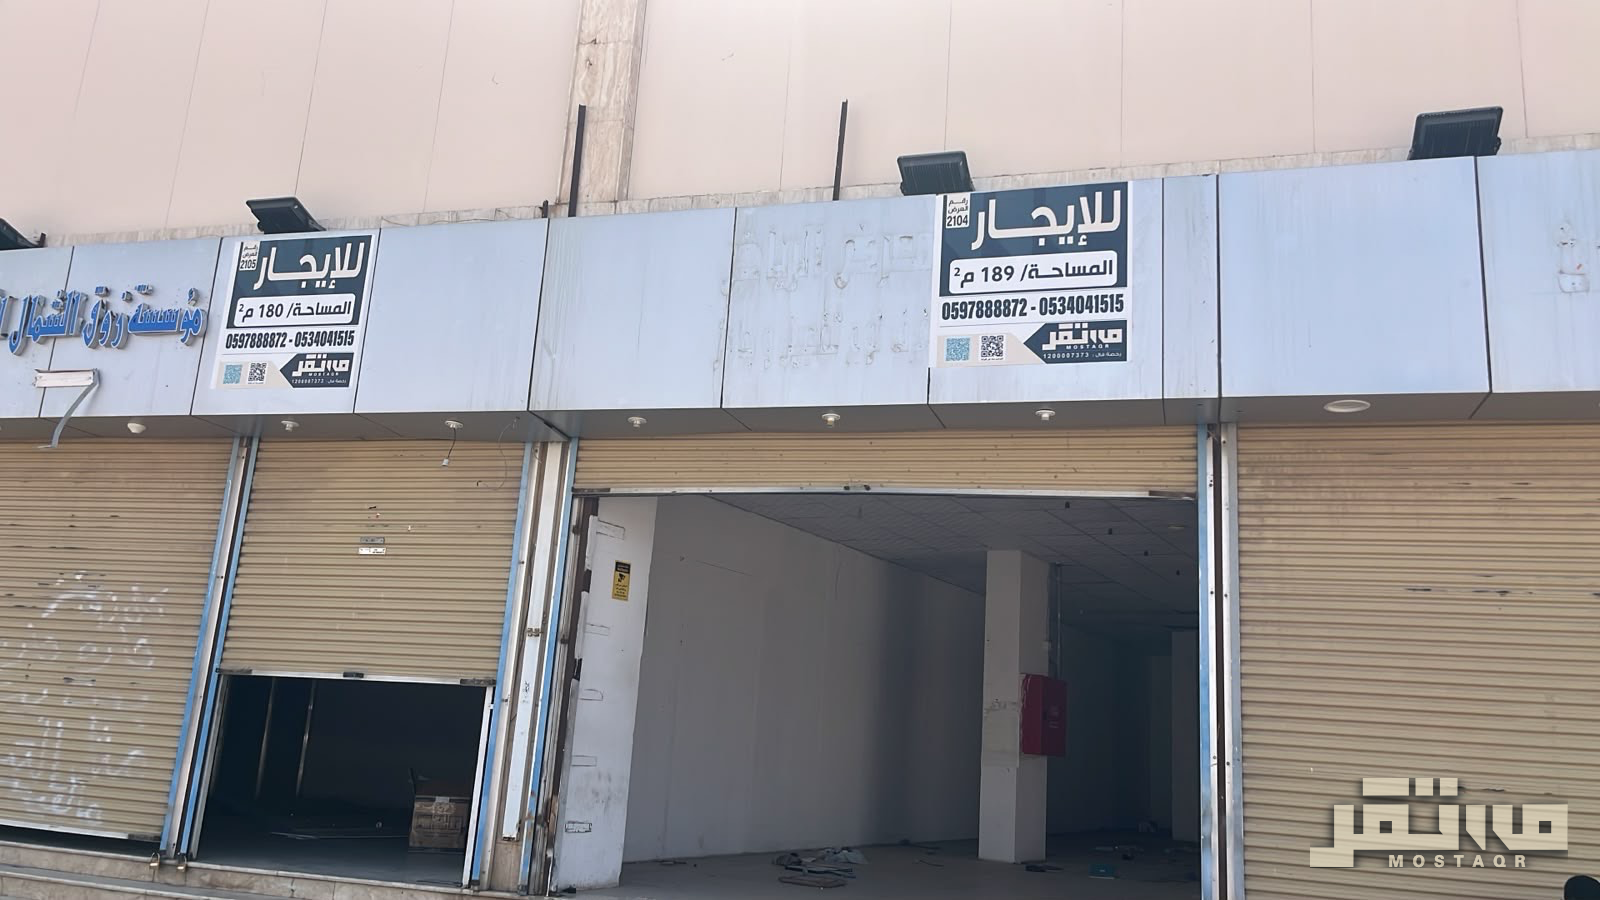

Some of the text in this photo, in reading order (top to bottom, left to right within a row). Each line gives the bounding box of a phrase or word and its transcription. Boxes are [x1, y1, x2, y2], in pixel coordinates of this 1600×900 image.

[946, 214, 968, 227] 2104
[971, 190, 1121, 250] للإيجار
[240, 259, 257, 270] 2105
[253, 242, 365, 290] للإيجار
[981, 265, 1015, 282] 189
[259, 303, 284, 318] 180
[941, 298, 1028, 320] 0597888872
[1039, 293, 1124, 316] 0534041515
[8, 290, 85, 354] الشمال
[225, 332, 288, 349] 0597888872
[294, 330, 355, 348] 0534041515
